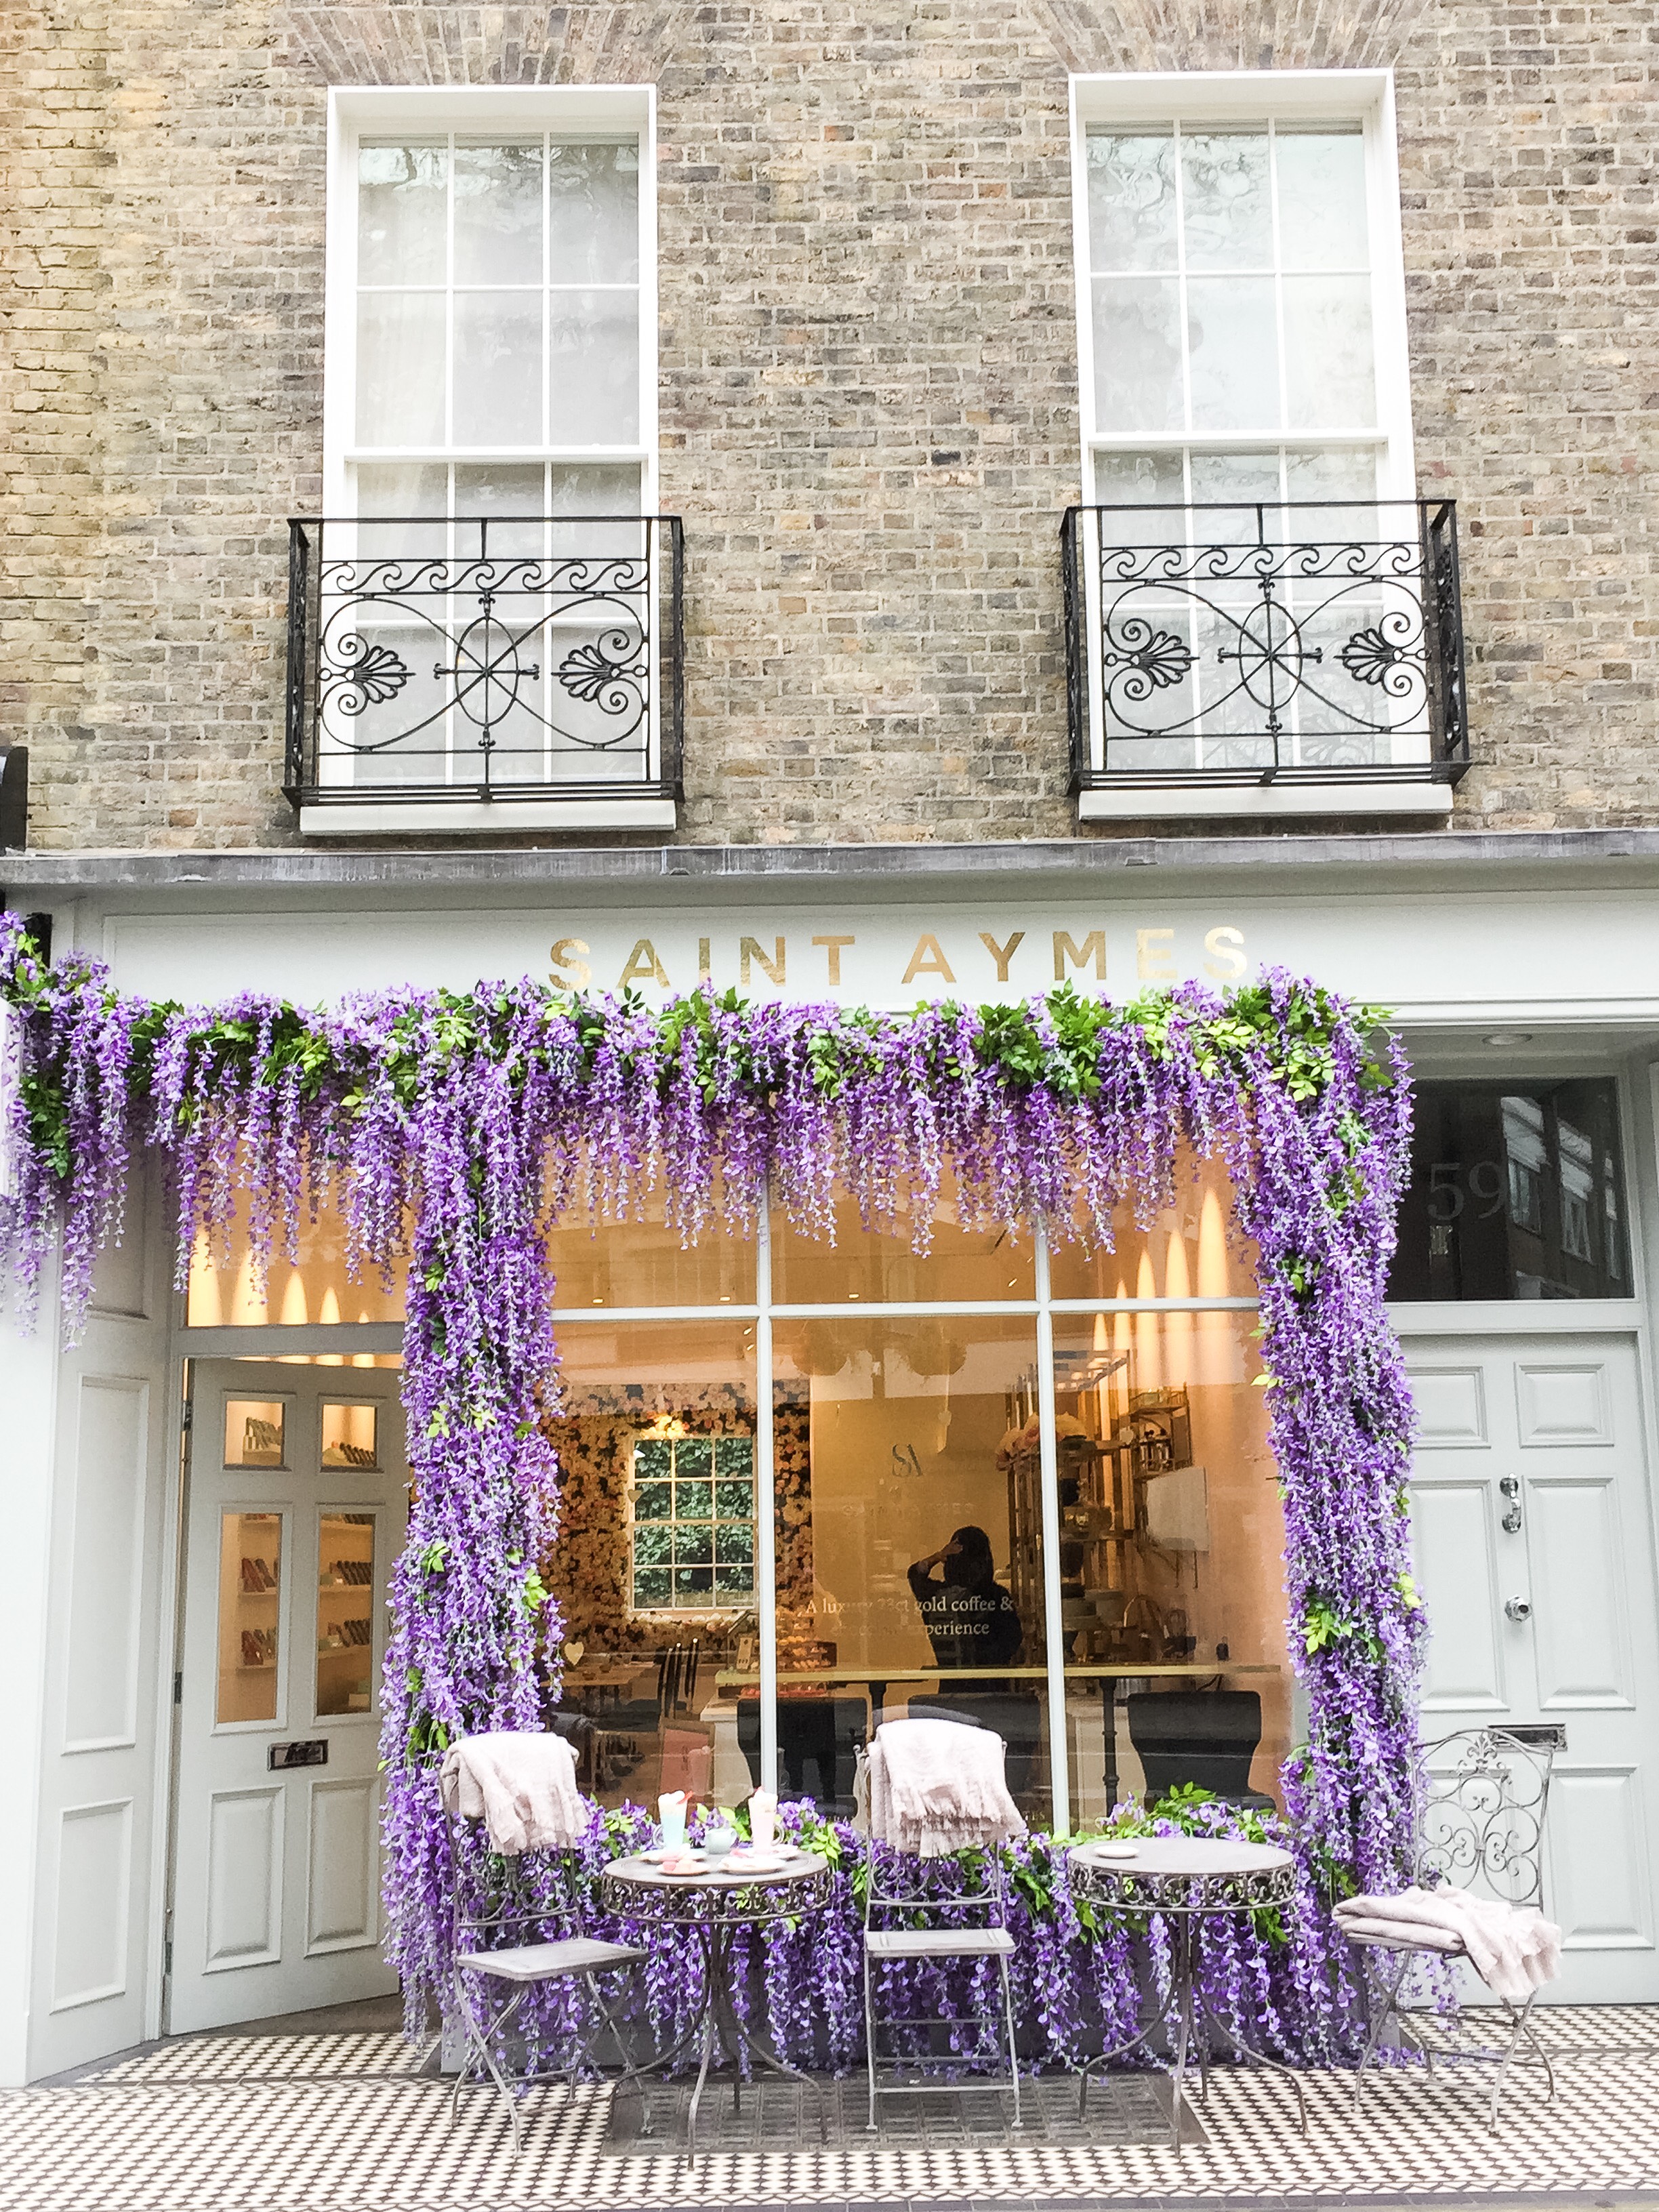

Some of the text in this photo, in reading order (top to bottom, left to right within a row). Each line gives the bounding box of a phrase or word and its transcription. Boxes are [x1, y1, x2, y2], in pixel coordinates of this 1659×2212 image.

[548, 926, 1248, 990] SAINT AYMES
[1427, 1161, 1509, 1221] 59
[806, 1599, 817, 1614] A
[823, 1597, 873, 1614] lux
[951, 1595, 996, 1612] coffee
[1000, 1596, 1014, 1612] &
[909, 1620, 990, 1637] perience
